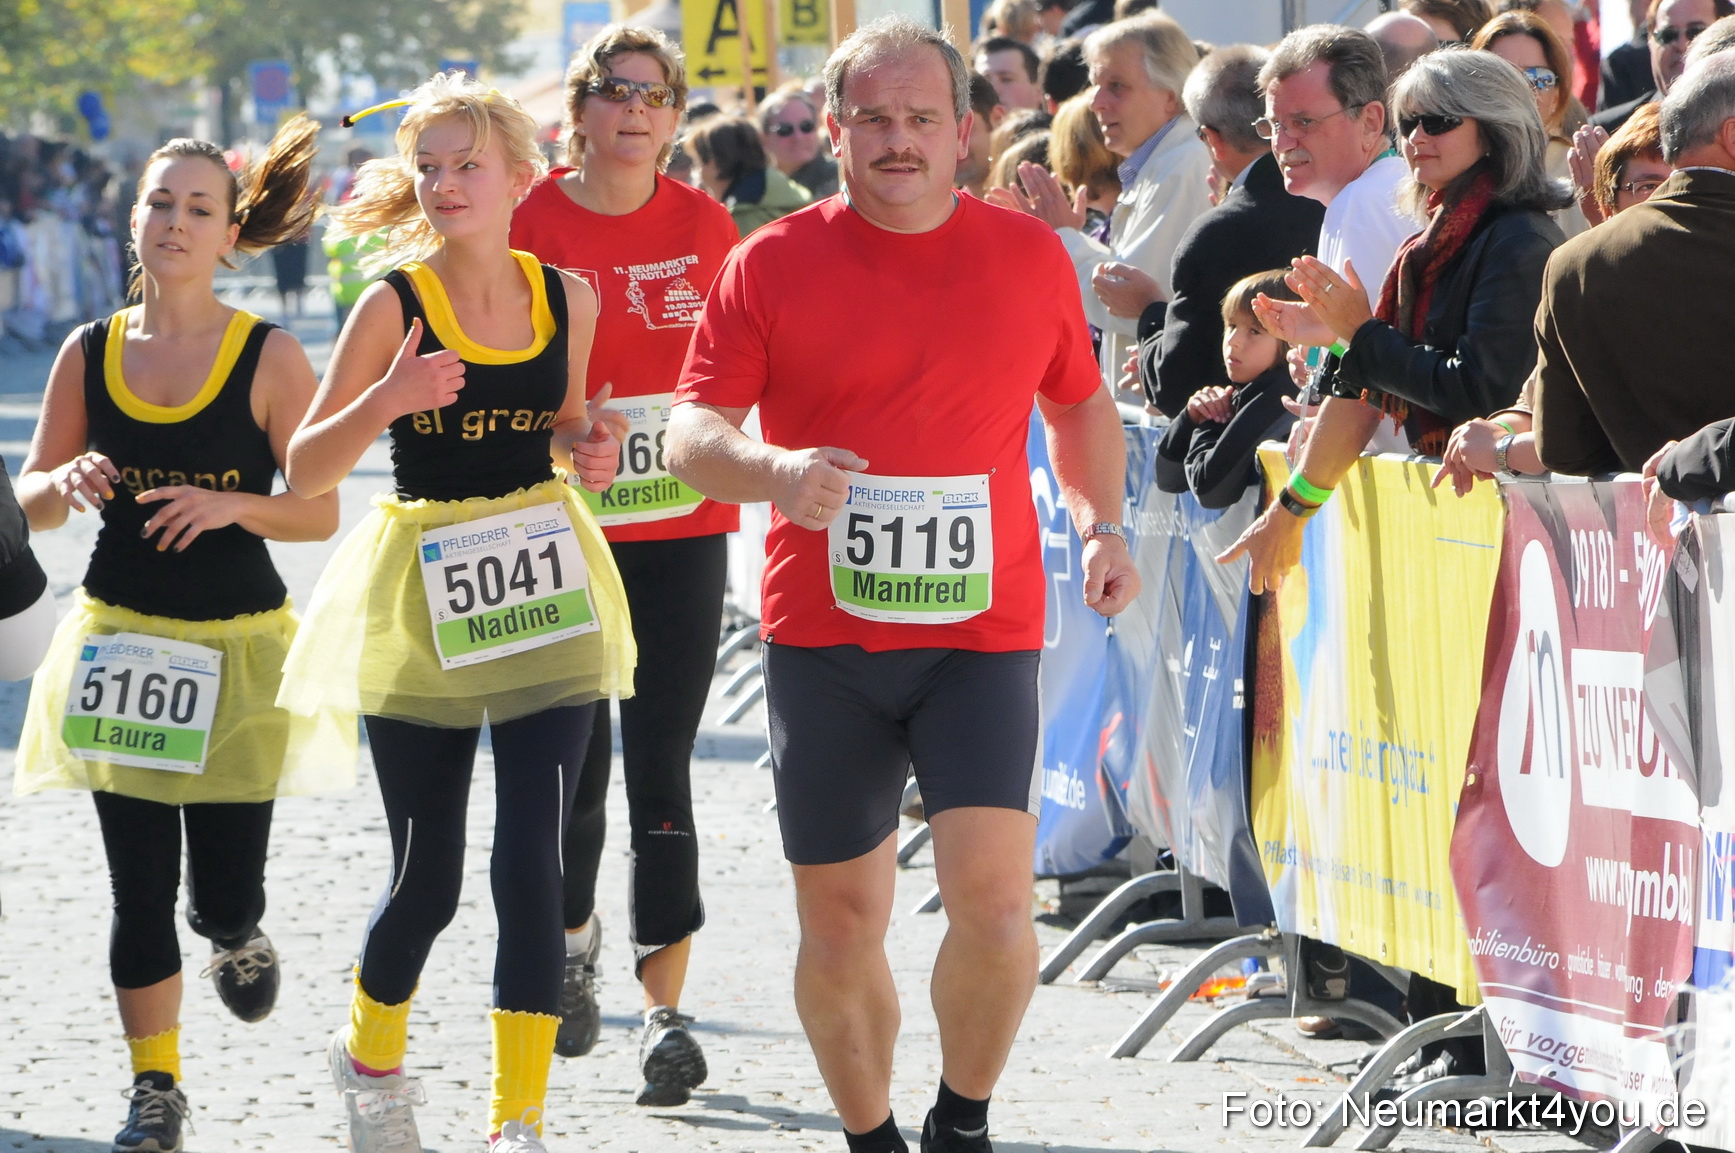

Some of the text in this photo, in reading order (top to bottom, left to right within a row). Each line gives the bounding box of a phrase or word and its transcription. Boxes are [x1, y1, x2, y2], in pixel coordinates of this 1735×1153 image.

[706, 0, 756, 54] A
[794, 0, 818, 27] B
[628, 255, 699, 274] NEUMARKTER
[629, 266, 687, 281] STADTLAUF
[412, 407, 558, 441] el gran
[121, 466, 240, 494] grano
[601, 478, 680, 508] Kerstin
[854, 486, 979, 503] PFLEIDERER BOCK
[854, 501, 925, 511] AKTIENGESELLSCHAFT
[442, 519, 559, 552] PFLEIDERER BOCK
[445, 540, 512, 560] AKTIENGESELLSCHAFT
[846, 512, 975, 570] 5119
[835, 554, 841, 562] S
[1570, 529, 1614, 608] 09181
[444, 541, 563, 614] 5041
[853, 571, 967, 604] Manfred
[438, 611, 445, 620] S
[468, 603, 560, 644] Nadine
[81, 666, 199, 724] 5160
[93, 718, 166, 751] Laura
